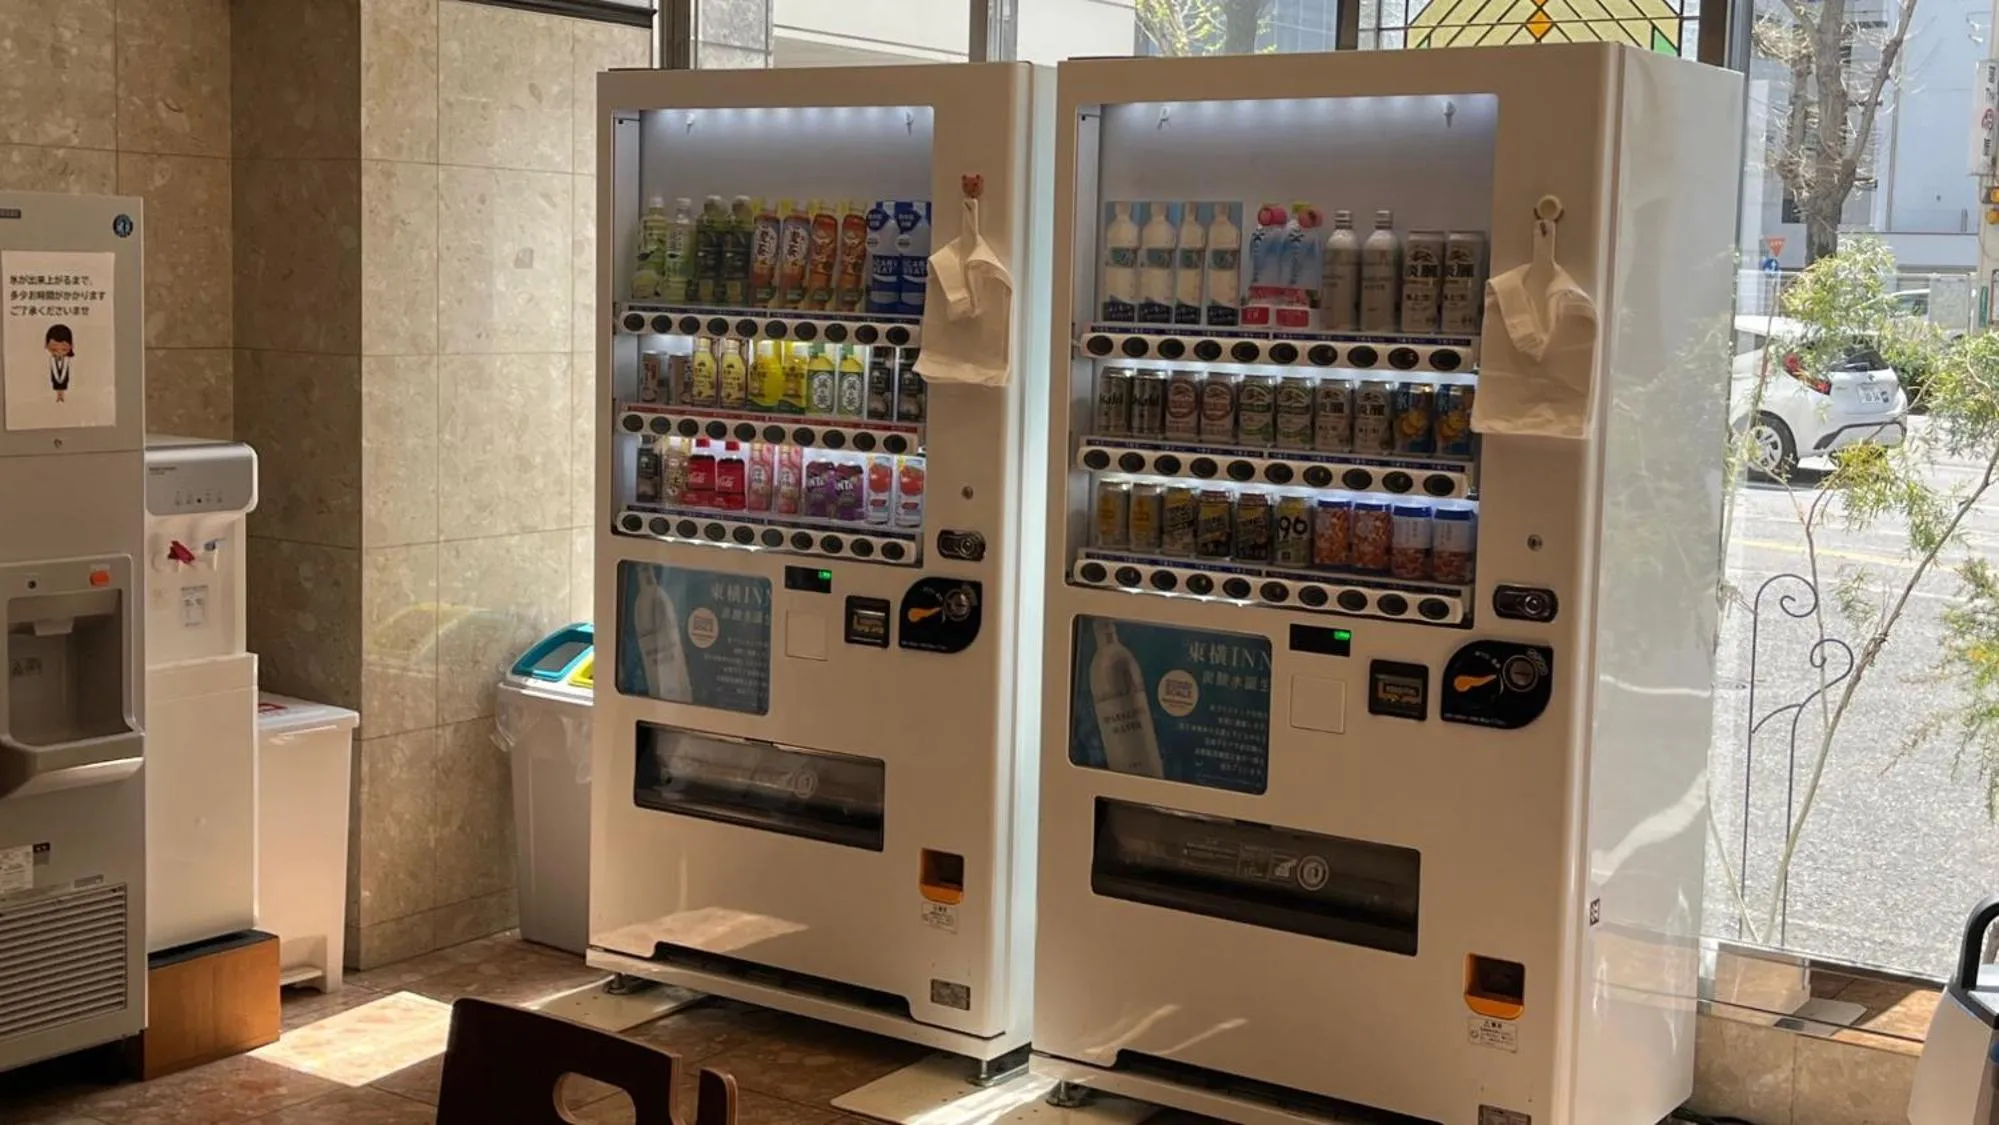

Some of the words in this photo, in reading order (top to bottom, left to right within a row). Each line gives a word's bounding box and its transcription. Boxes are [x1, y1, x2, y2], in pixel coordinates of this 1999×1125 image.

[10, 290, 106, 301] 多少お時間がかかります
[10, 305, 90, 316] ご了承くださいませ
